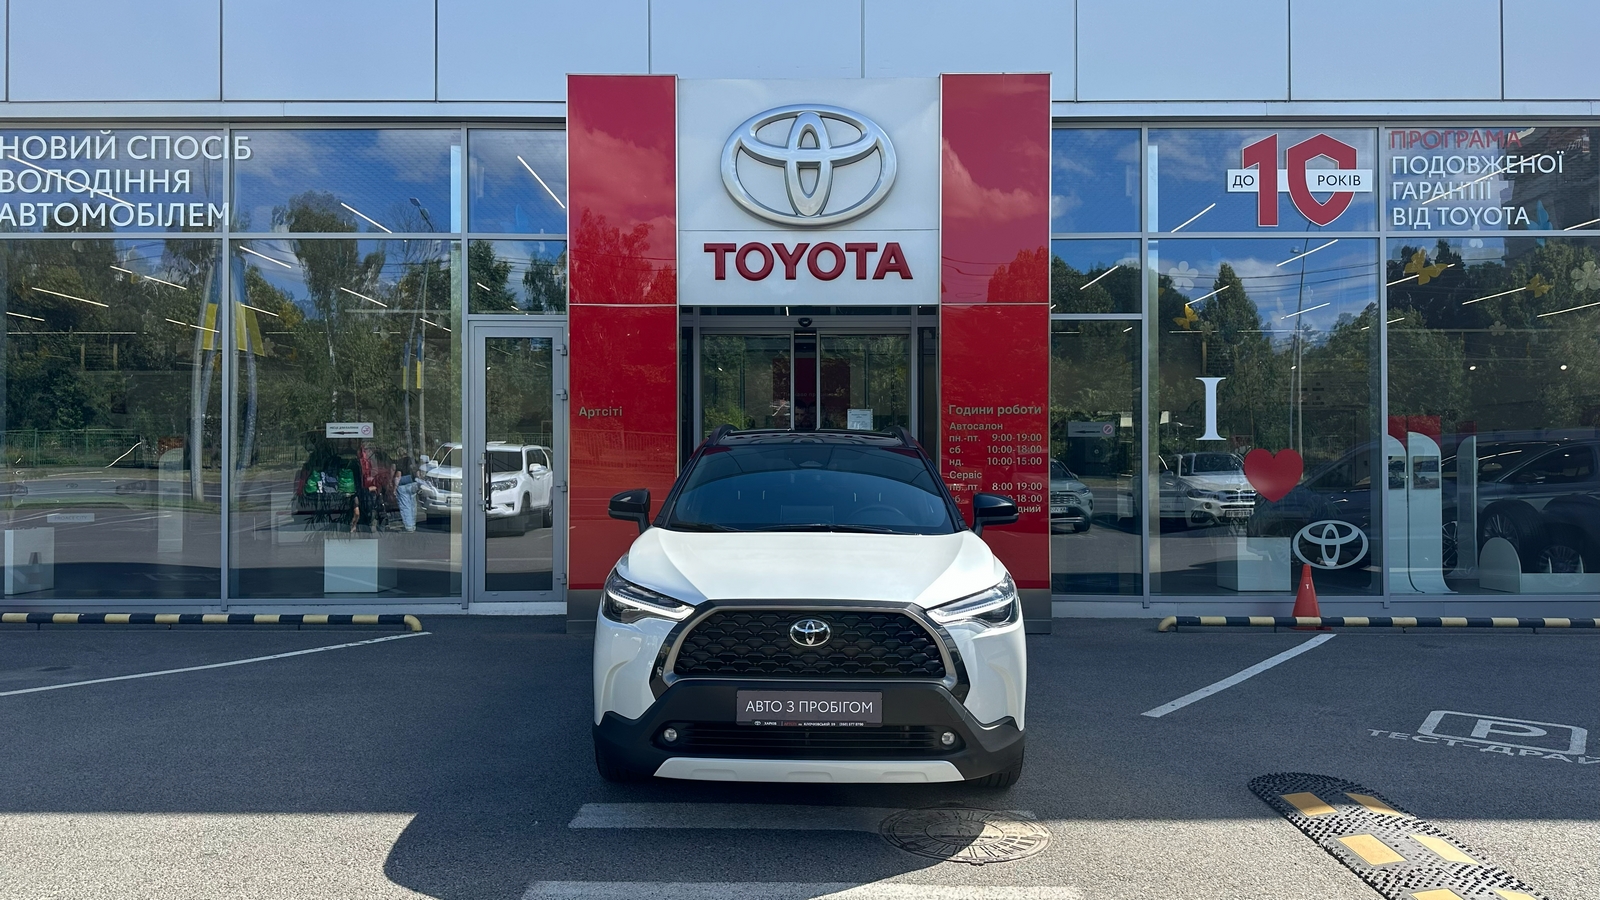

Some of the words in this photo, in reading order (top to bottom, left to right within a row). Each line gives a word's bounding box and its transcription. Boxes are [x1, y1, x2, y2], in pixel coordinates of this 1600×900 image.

[0, 130, 116, 160] НОВИЙ
[127, 135, 252, 160] СПОСІБ
[1391, 130, 1522, 149] ПРОГРАМА
[1392, 150, 1565, 178] ПОДОВЖЕНОЇ
[0, 168, 191, 198] ВОЛОДІННЯ
[1232, 174, 1255, 188] ДО
[1317, 174, 1361, 186] РОКІВ
[1393, 177, 1492, 200] ГАРАНТІЇ
[0, 202, 230, 227] АВТОМОБІЛЕМ
[1393, 207, 1431, 229] ВІД
[1436, 206, 1531, 225] TOYOTA
[703, 241, 914, 282] TOYOTA
[578, 406, 623, 419] Артсіті
[948, 404, 994, 416] Години
[997, 404, 1042, 417] роботи
[1195, 377, 1227, 441] I
[949, 422, 1004, 431] Автосалон
[949, 446, 964, 454] сб.
[949, 470, 983, 481] Сервіс
[745, 700, 783, 713] АВТО
[799, 701, 874, 714] ПРОБІГОМ
